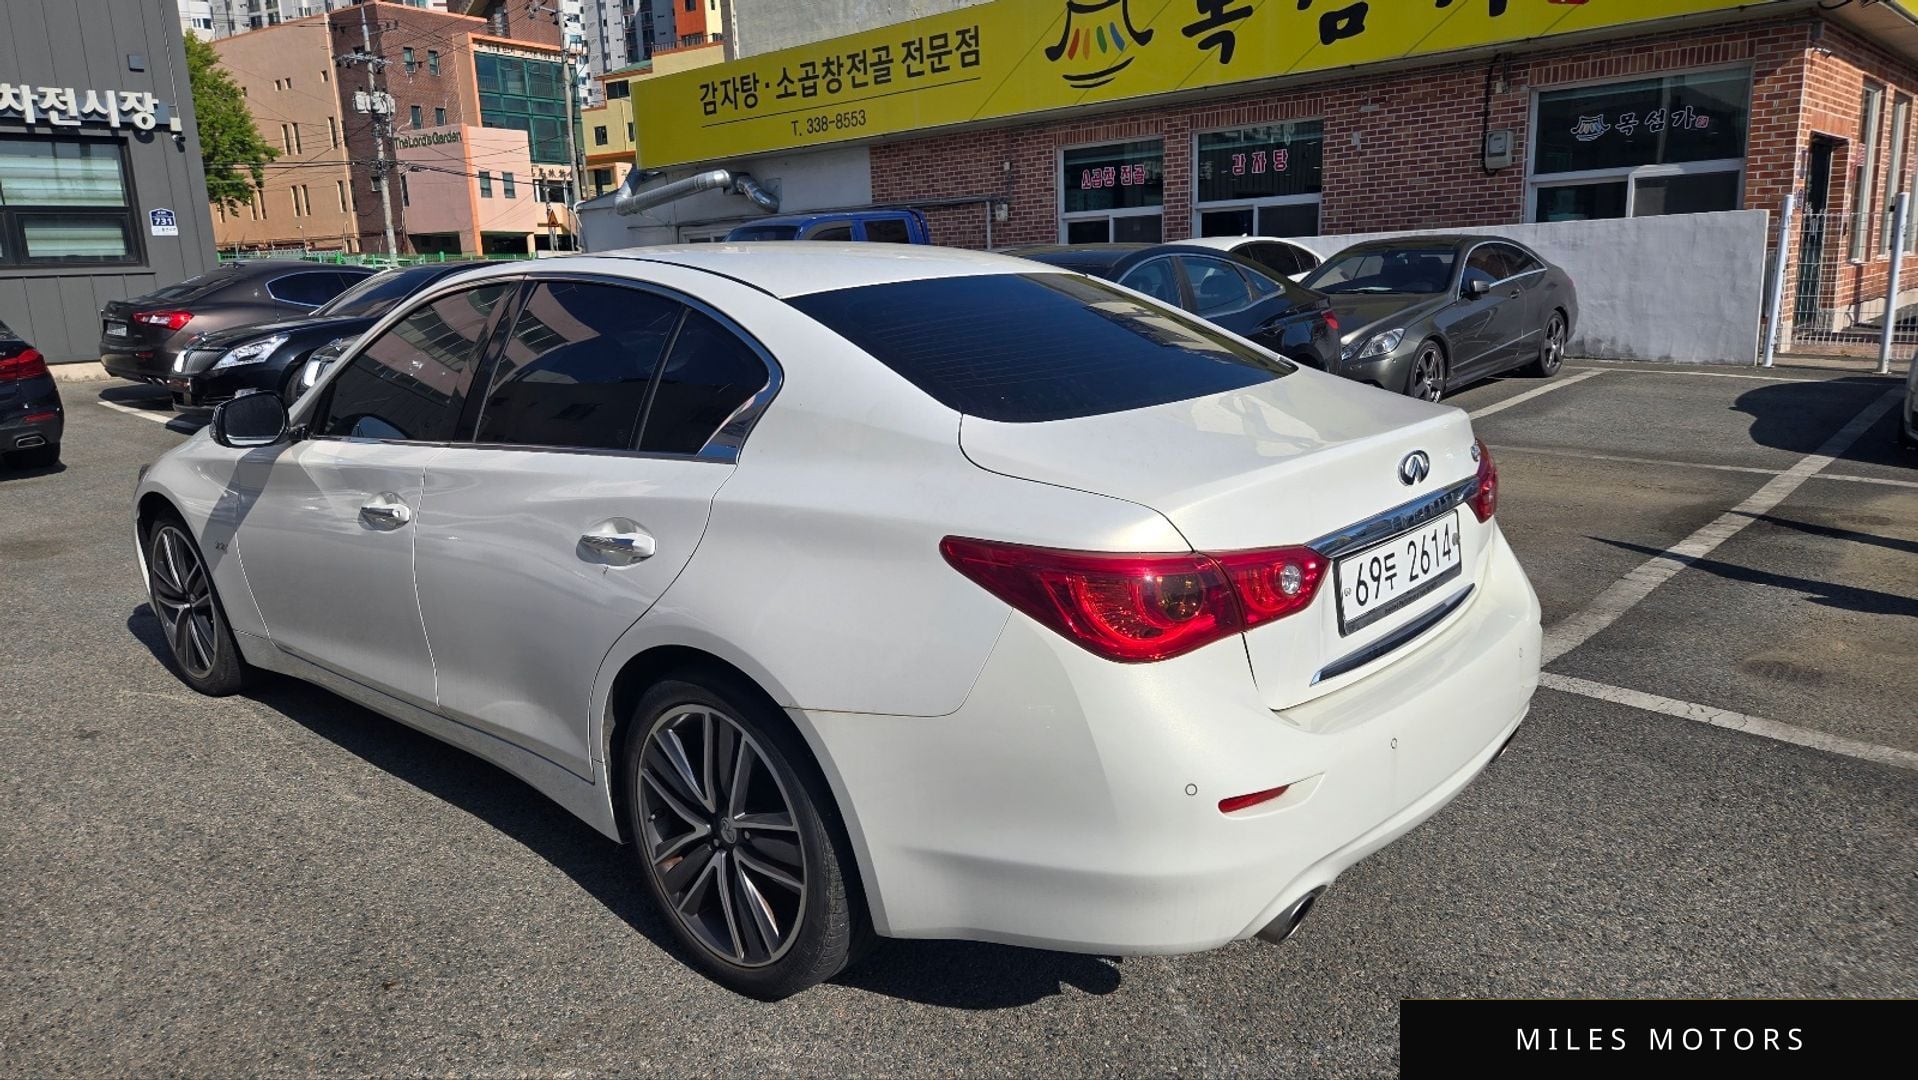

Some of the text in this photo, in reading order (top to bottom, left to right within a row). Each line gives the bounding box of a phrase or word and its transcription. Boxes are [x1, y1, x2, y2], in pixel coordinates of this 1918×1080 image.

[901, 25, 981, 79] 전문점
[791, 109, 867, 136] T. 338-8553
[1120, 164, 1145, 186] 전골
[154, 217, 174, 226] 731
[1355, 552, 1398, 607] 69두
[1407, 523, 1453, 583] 2614
